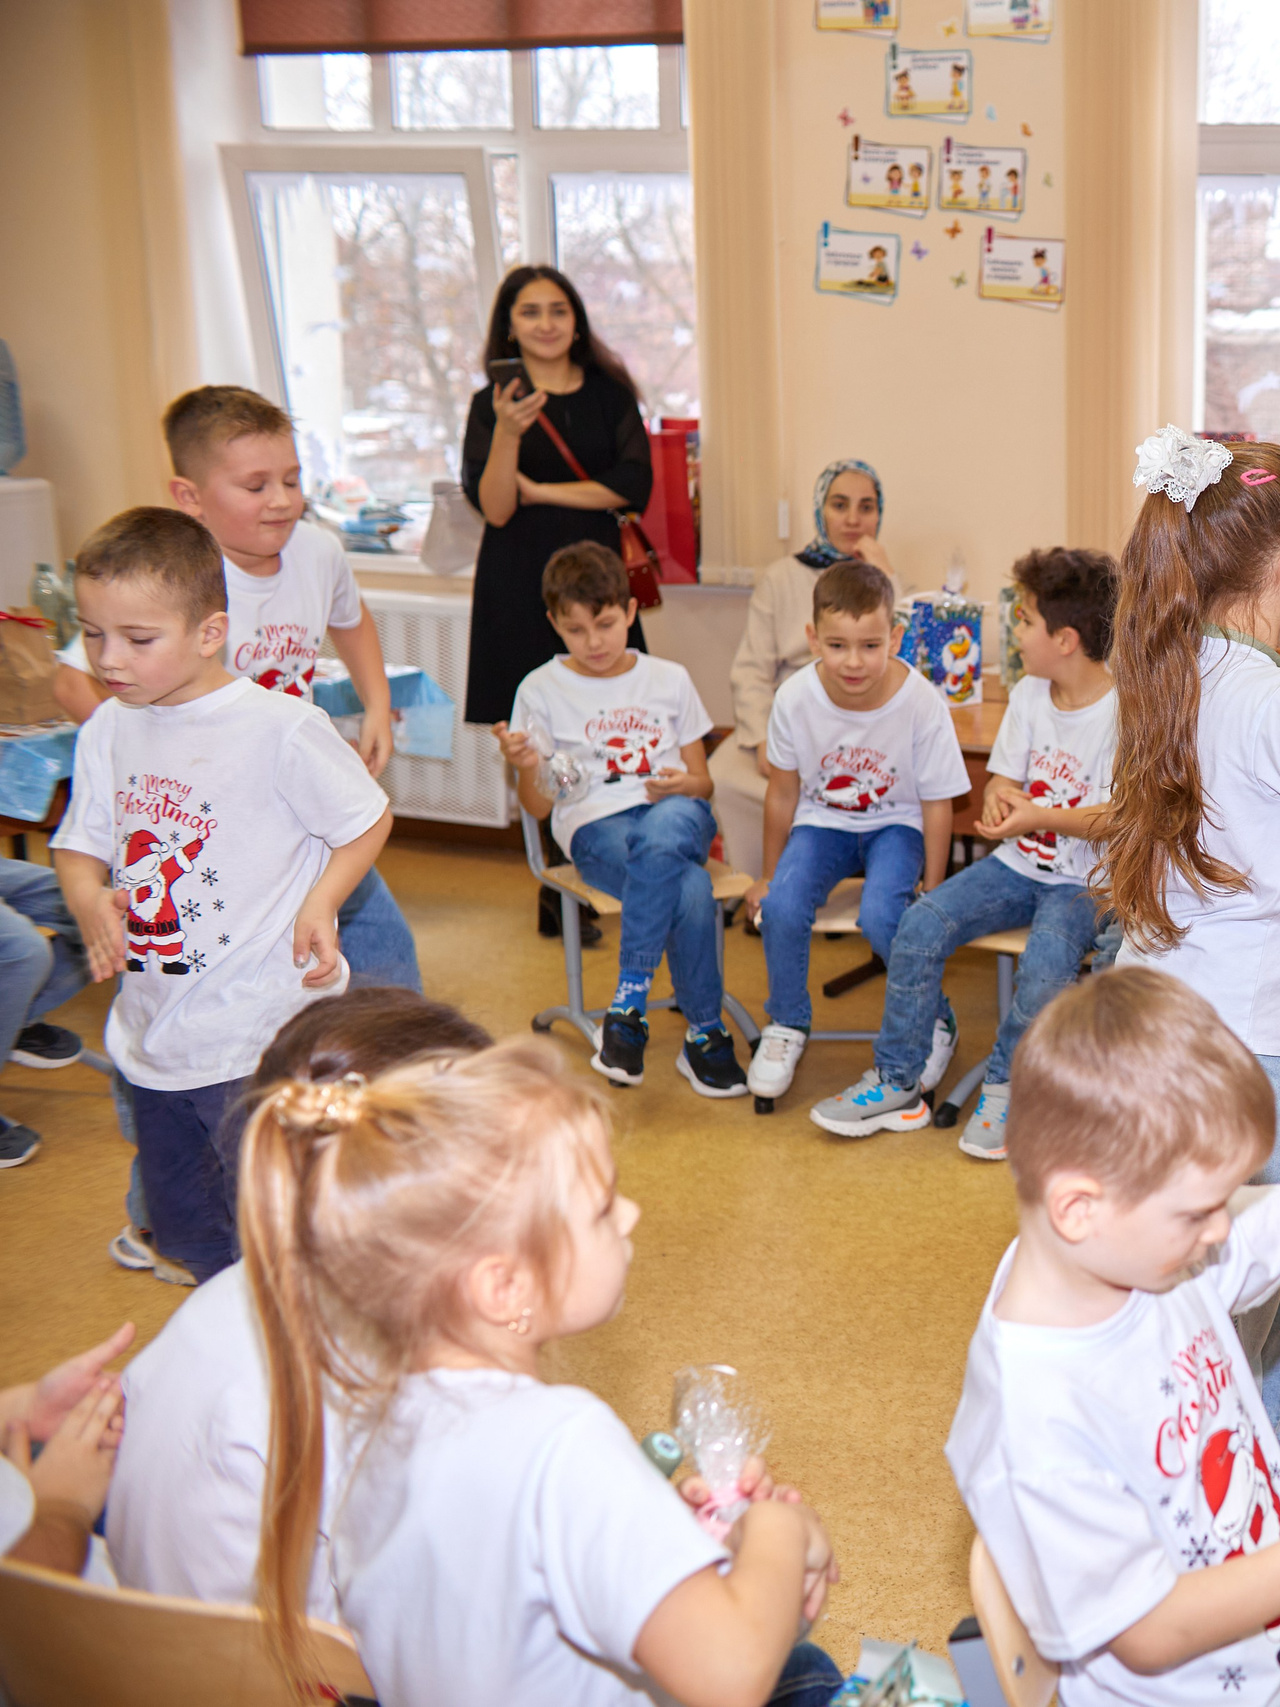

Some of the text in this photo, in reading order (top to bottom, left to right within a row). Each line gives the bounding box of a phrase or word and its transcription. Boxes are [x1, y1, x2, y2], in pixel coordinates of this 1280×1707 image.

[234, 636, 317, 671] Christma
[820, 751, 899, 787] Christmas
[140, 774, 193, 802] Merry
[114, 791, 218, 841] Christmas
